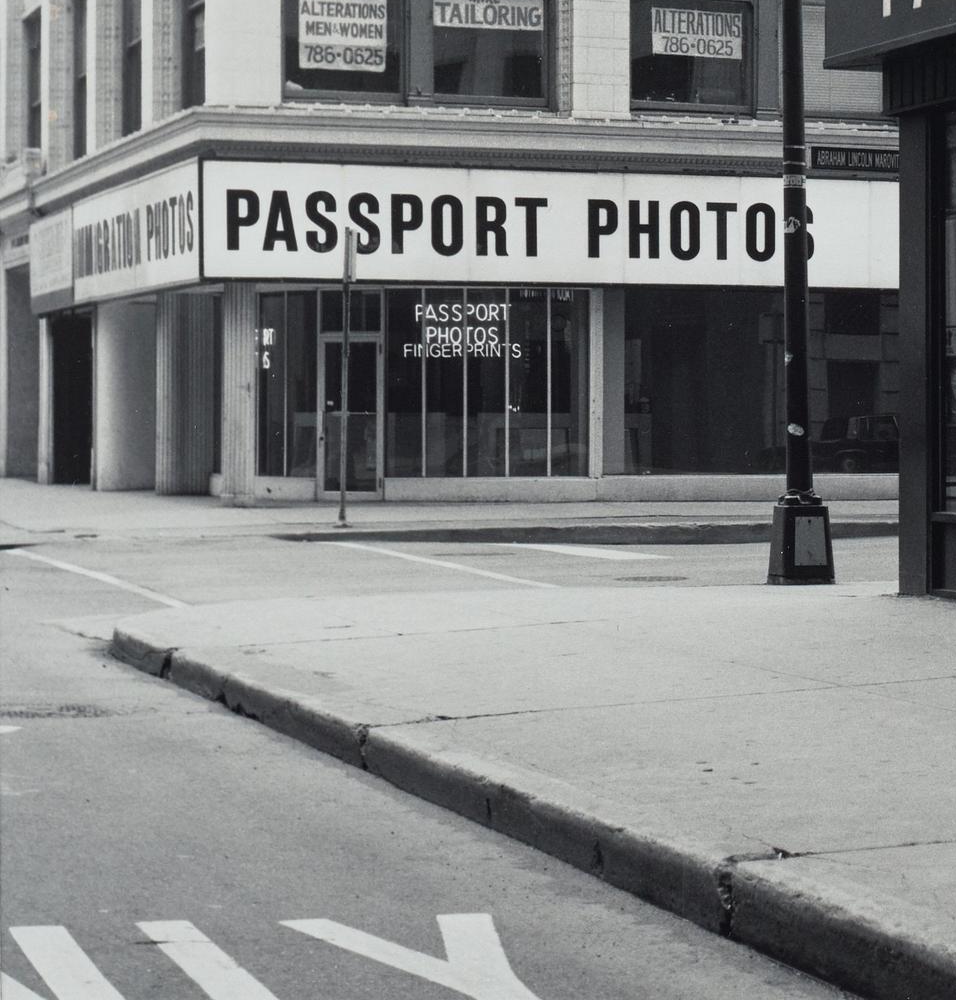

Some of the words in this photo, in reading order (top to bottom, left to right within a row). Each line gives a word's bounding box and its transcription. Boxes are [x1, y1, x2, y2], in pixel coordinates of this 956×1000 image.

[301, 0, 385, 19] ALTERATIONS
[435, 2, 541, 27] TAILORING
[655, 9, 740, 38] ALTERATIONS
[816, 151, 846, 166] ABRAHAM
[848, 152, 873, 167] LINCOLN
[146, 190, 194, 262] PHOTOS
[227, 189, 548, 257] PASSPORT
[415, 304, 512, 322] PASSPORT
[426, 327, 498, 345] PHOTOS
